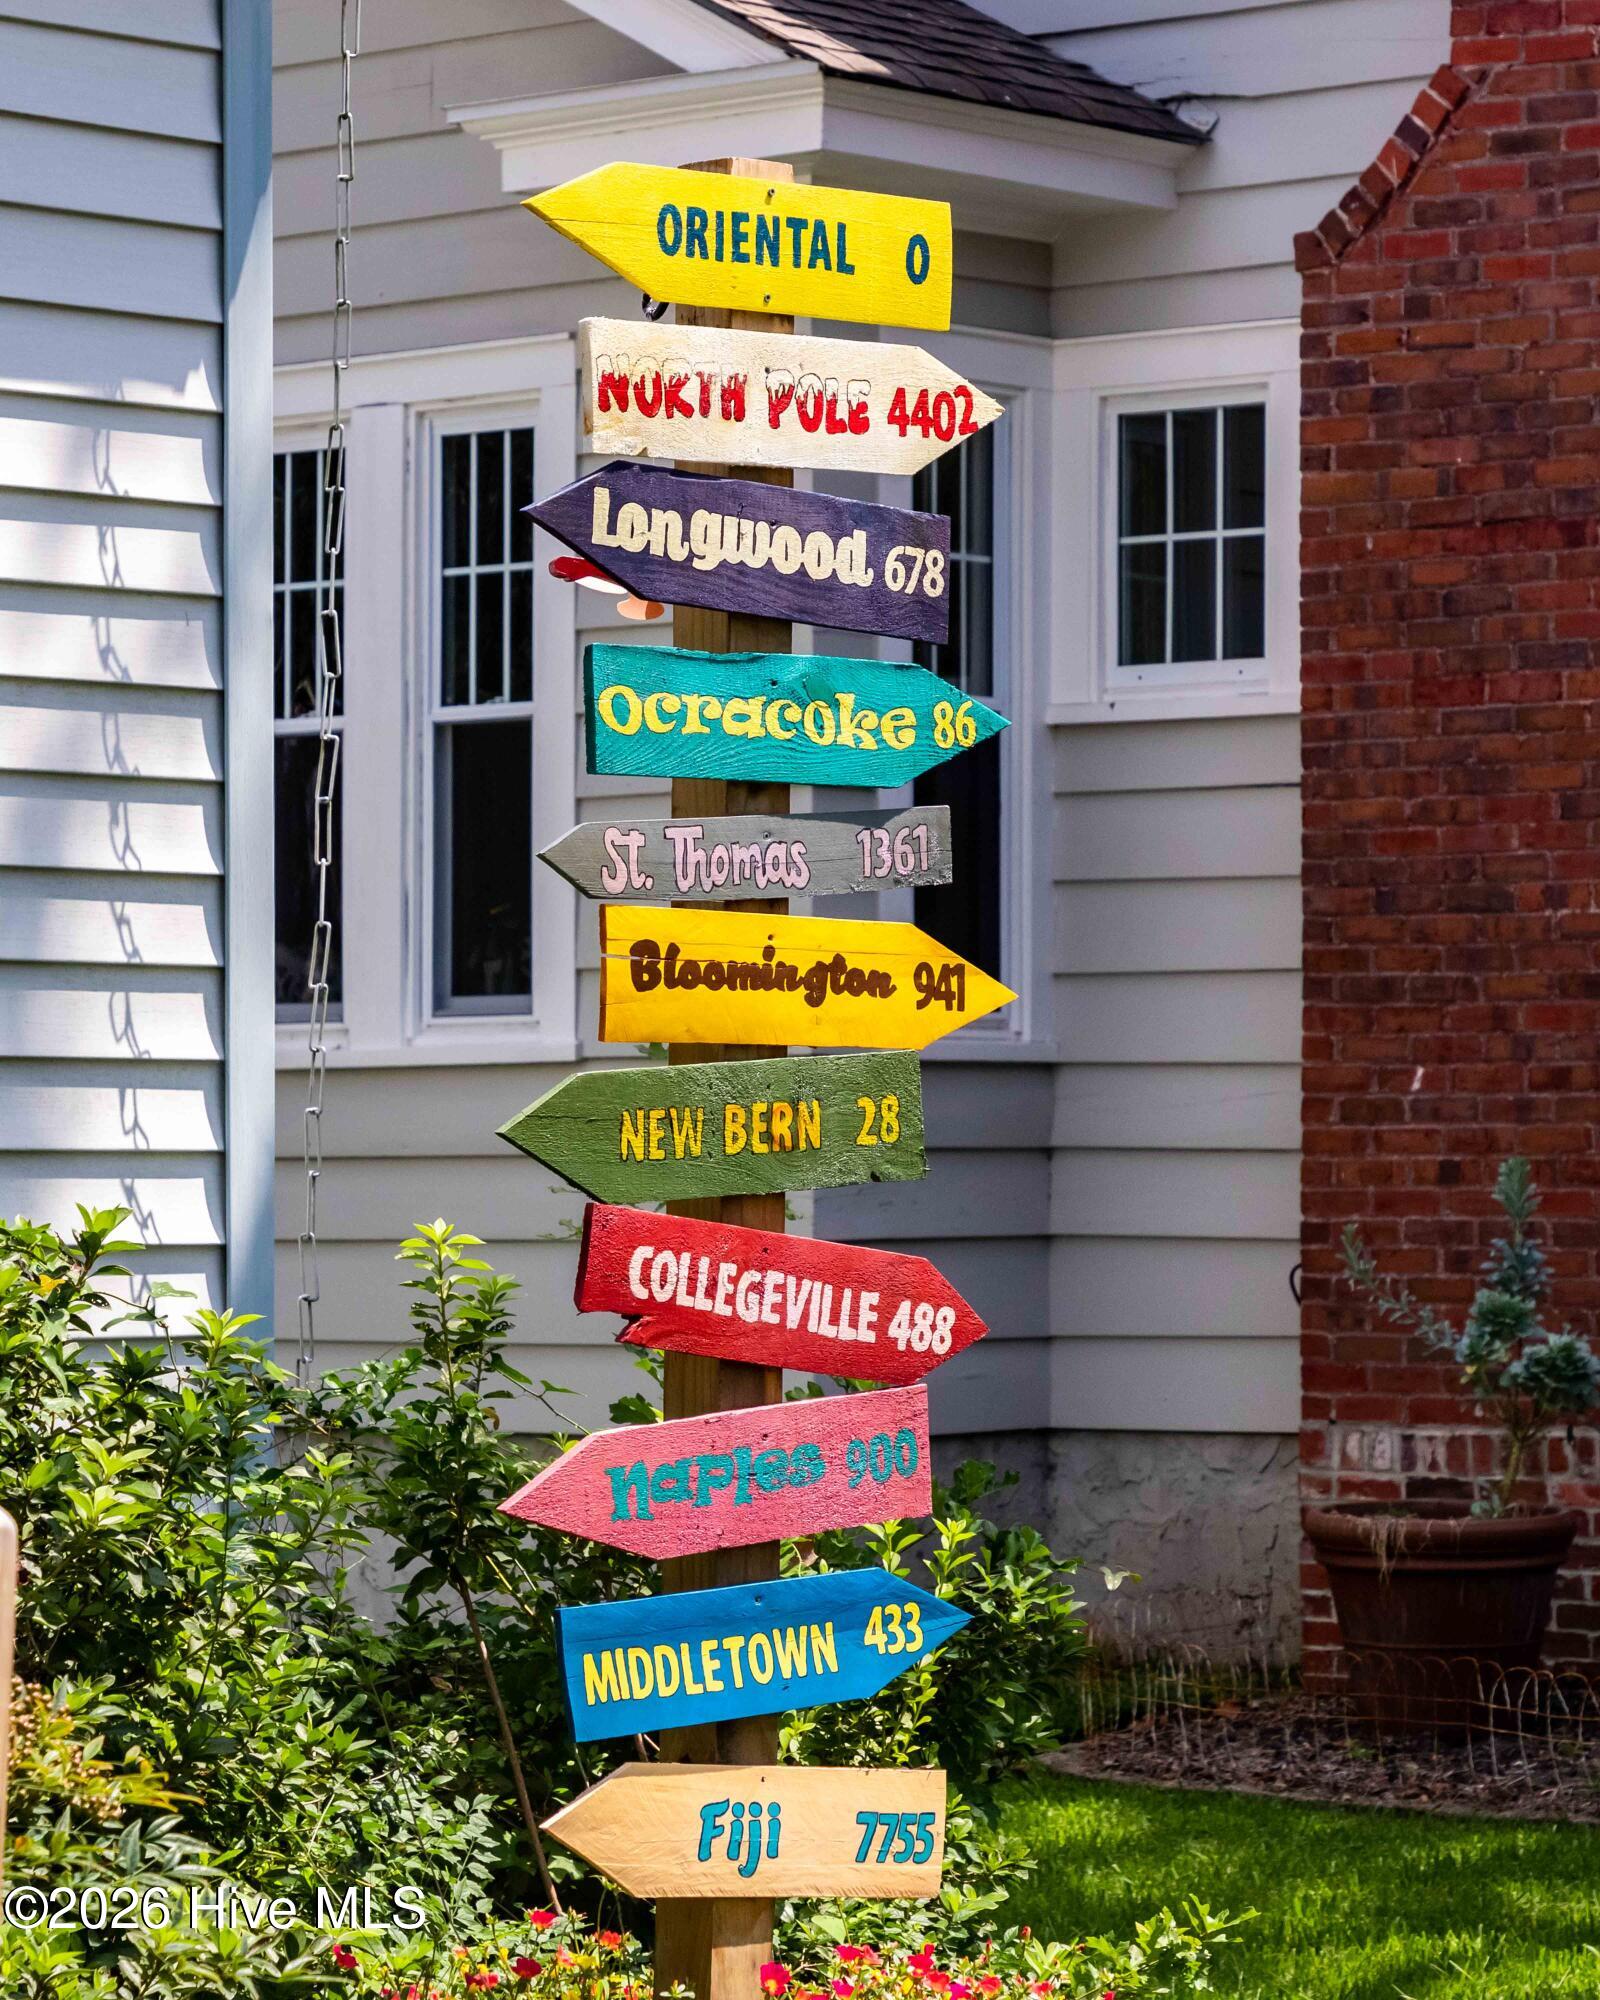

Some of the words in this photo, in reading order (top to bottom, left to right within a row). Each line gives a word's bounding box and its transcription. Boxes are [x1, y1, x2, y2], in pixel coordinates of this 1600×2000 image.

[657, 203, 855, 275] ORIENTAL
[905, 233, 931, 285] 0
[596, 353, 747, 422] NORTH
[765, 368, 871, 435] POLE
[887, 385, 978, 442] 4402
[591, 487, 874, 587] Longwood
[884, 545, 945, 598] 678
[597, 685, 917, 751] Ocracoke
[932, 700, 977, 749] 86
[600, 826, 654, 895] St.
[664, 824, 811, 892] Thomas
[856, 823, 928, 878] 1361
[629, 939, 897, 1007] Bloomington
[913, 962, 966, 1012] 941
[619, 1106, 704, 1162] NEW
[723, 1100, 822, 1156] BERN
[855, 1094, 900, 1145] 28
[628, 1245, 880, 1344] COLLEGEVILLE
[887, 1300, 956, 1354] 488
[845, 1427, 917, 1489] 900
[583, 1621, 838, 1706] MIDDLETOWN
[863, 1601, 924, 1655] 433
[698, 1798, 781, 1878] Fiji
[854, 1811, 936, 1864] 7755
